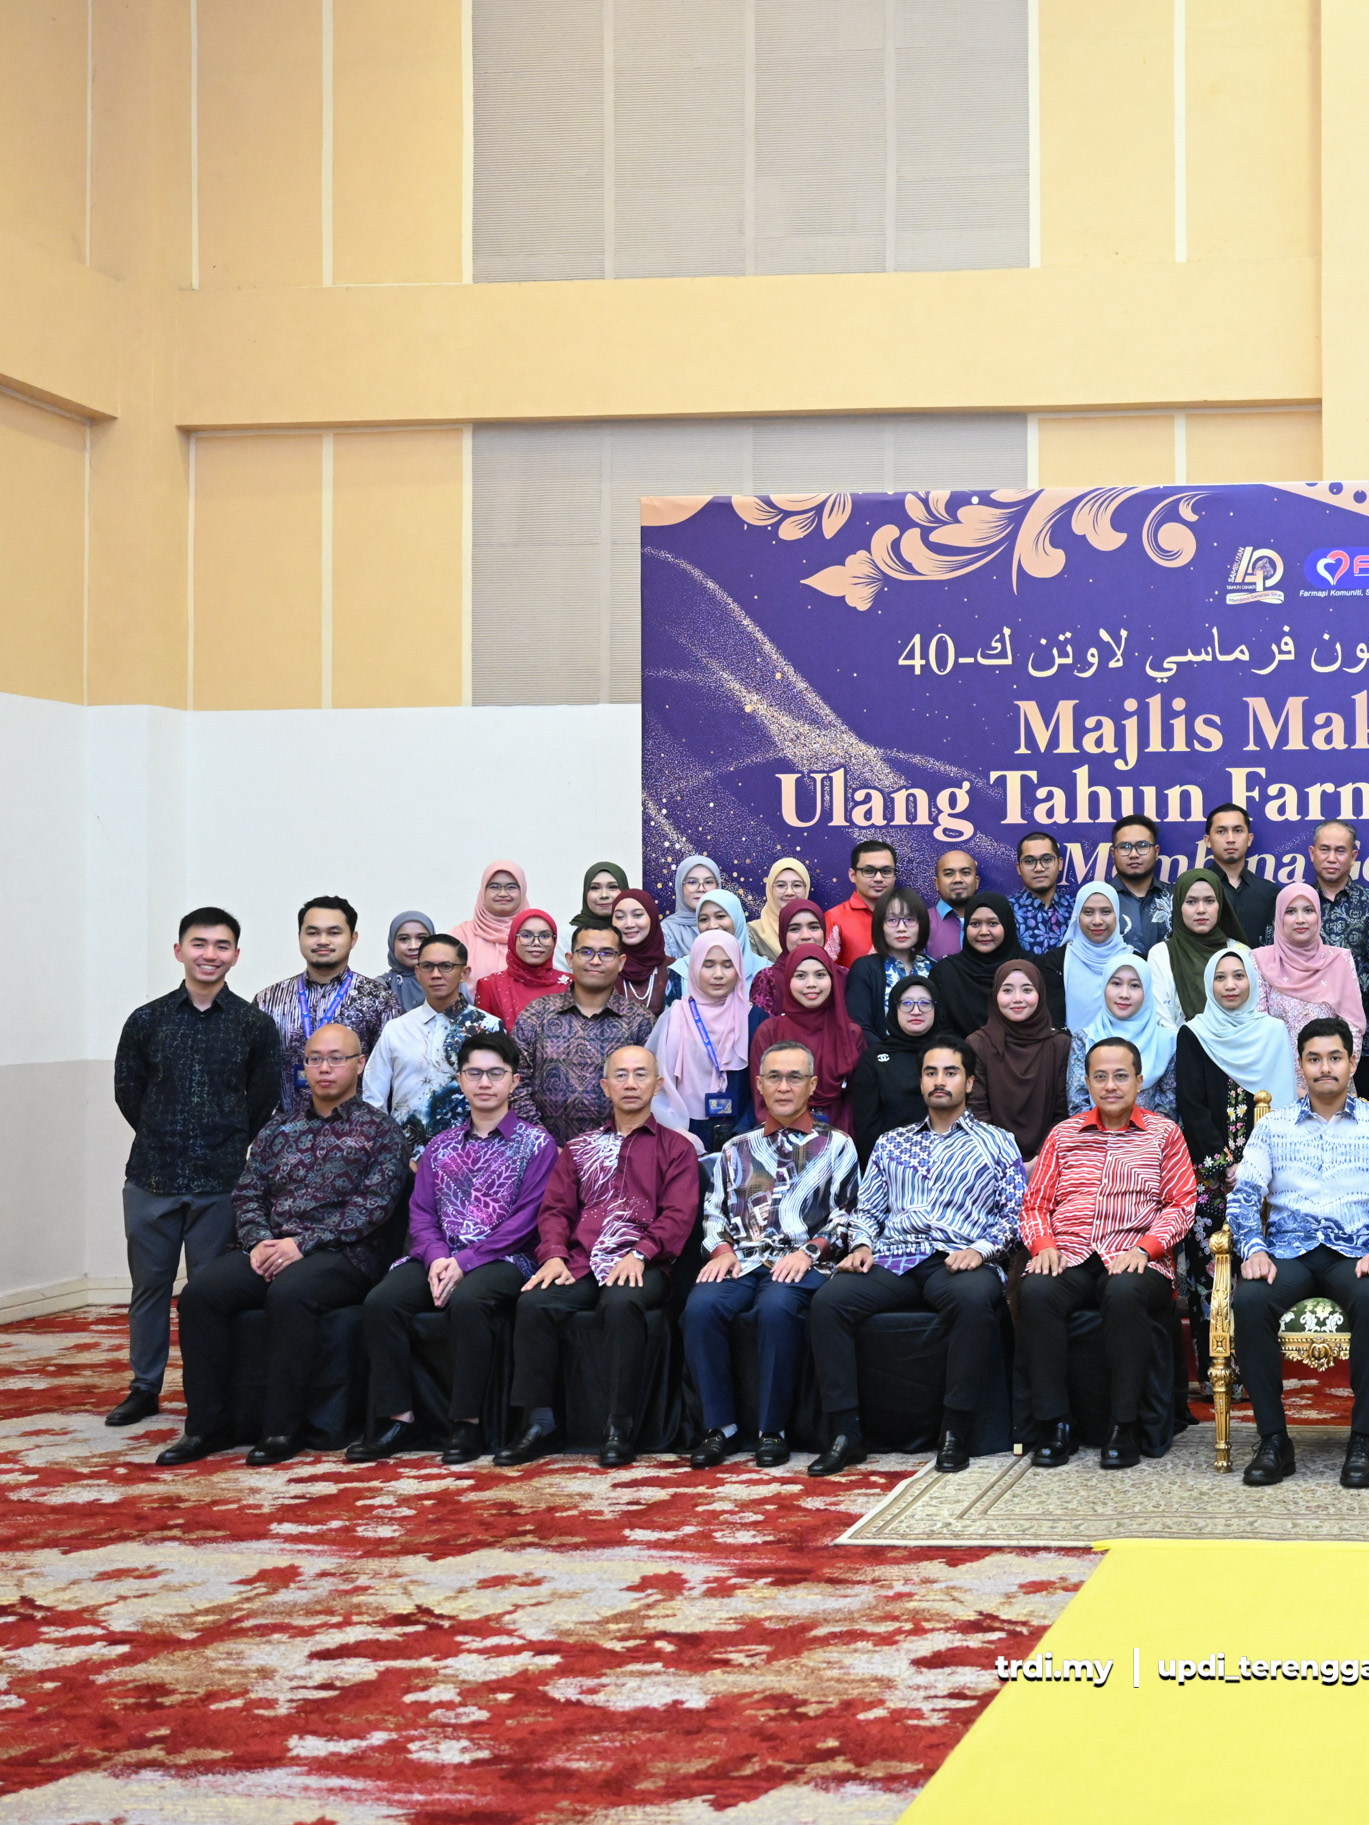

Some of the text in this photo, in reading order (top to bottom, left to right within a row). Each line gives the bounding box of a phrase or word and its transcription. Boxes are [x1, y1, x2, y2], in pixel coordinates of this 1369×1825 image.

[1299, 589, 1328, 597] Farmasi
[1330, 589, 1364, 597] Komuniti,
[1028, 628, 1128, 678] لاوتن
[1146, 624, 1295, 684] فرماسي
[1014, 692, 1224, 770] Majlis
[775, 764, 975, 842] Ulang
[990, 764, 1208, 825] Tahun
